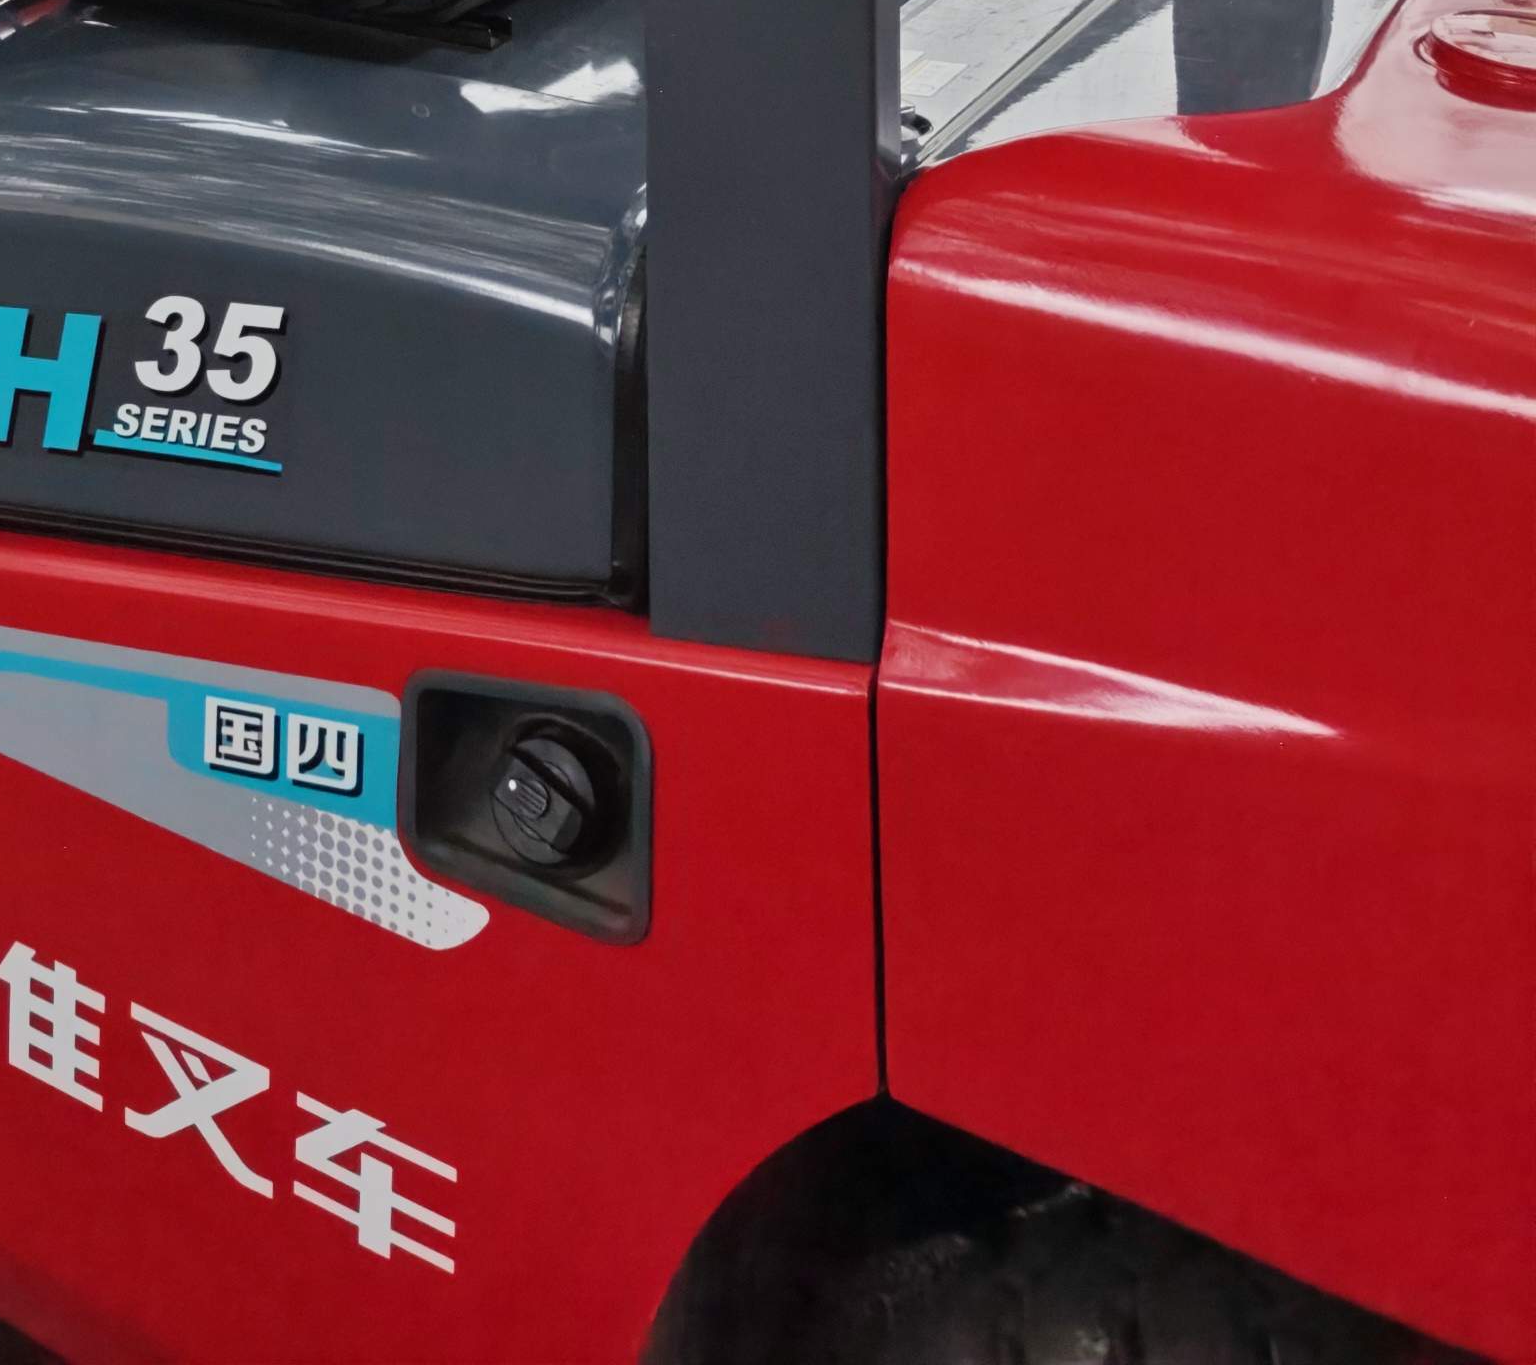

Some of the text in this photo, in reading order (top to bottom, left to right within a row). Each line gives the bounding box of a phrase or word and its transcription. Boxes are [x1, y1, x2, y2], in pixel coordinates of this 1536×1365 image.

[135, 295, 285, 401] 35
[113, 404, 268, 454] SERIES
[204, 696, 362, 794] 国四
